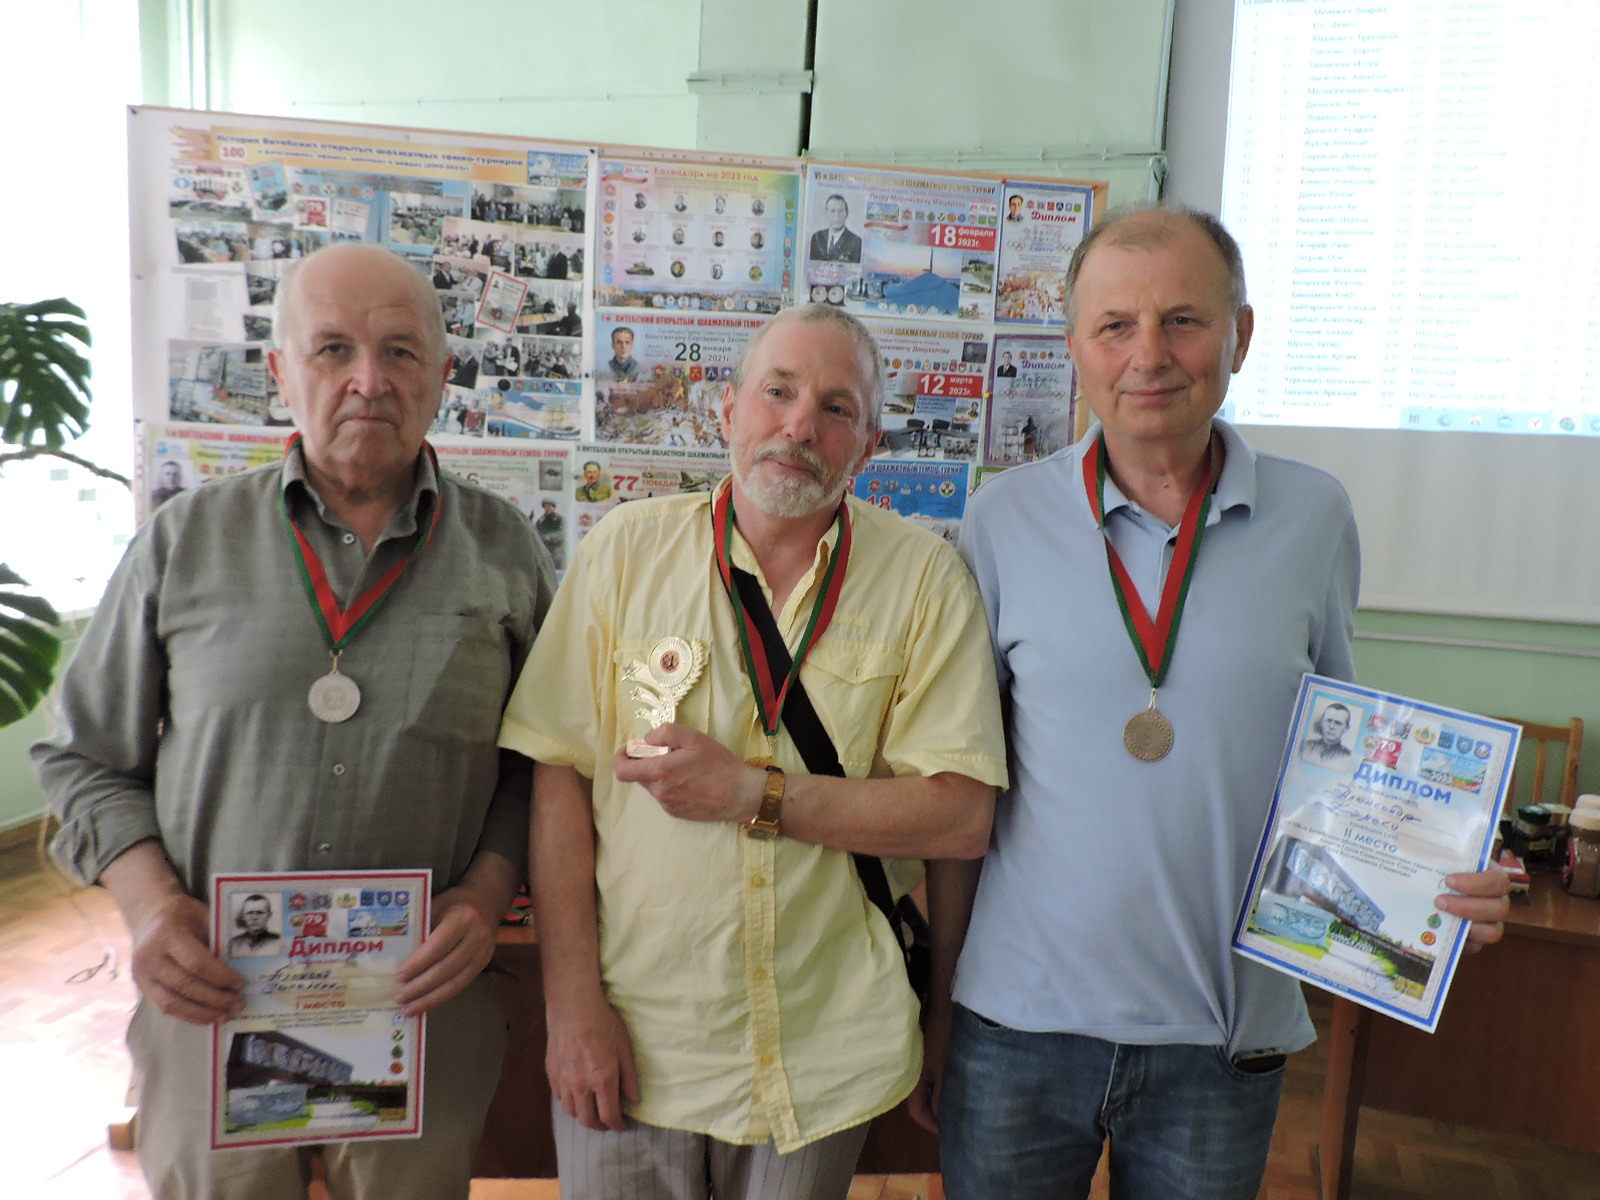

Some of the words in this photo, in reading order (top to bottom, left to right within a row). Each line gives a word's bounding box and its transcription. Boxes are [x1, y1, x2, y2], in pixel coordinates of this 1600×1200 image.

[320, 142, 374, 153] открытых
[377, 148, 439, 160] шахматных
[654, 167, 704, 180] Календарь
[706, 171, 718, 179] на
[721, 171, 741, 181] 2023
[743, 173, 759, 183] год
[905, 179, 948, 191] ШАХМАТНЫЙ
[1031, 211, 1077, 223] Диплом
[931, 224, 956, 247] 18
[958, 228, 994, 238] февраля
[957, 237, 981, 248] 2023г.
[616, 315, 654, 325] ВИТЕБСКИЙ
[656, 316, 695, 326] ОТКРЫТЫЙ
[697, 318, 742, 328] ШАХМАТНЫЙ
[645, 333, 686, 341] Константину
[895, 327, 937, 338] ШАХМАТНЫЙ
[675, 343, 702, 362] 28
[708, 354, 730, 362] 2021г
[1022, 359, 1066, 370] Диплом
[921, 375, 946, 395] 12
[950, 377, 974, 385] марта
[948, 387, 973, 396] 2023г.
[472, 447, 517, 457] ШАХМАТНЫЙ
[582, 445, 616, 454] ВИТЕБСКИЙ
[618, 447, 651, 456] ОТКРЫТЫЙ
[652, 449, 686, 457] ОБЛАСТНОЙ
[687, 451, 726, 459] ШАХМАТНЫЙ
[876, 462, 918, 473] ШАХМАТНЫЙ
[613, 475, 639, 491] 77
[1344, 828, 1353, 839] II
[1355, 834, 1398, 853] место
[288, 938, 384, 958] Диплом
[303, 1000, 347, 1010] место
